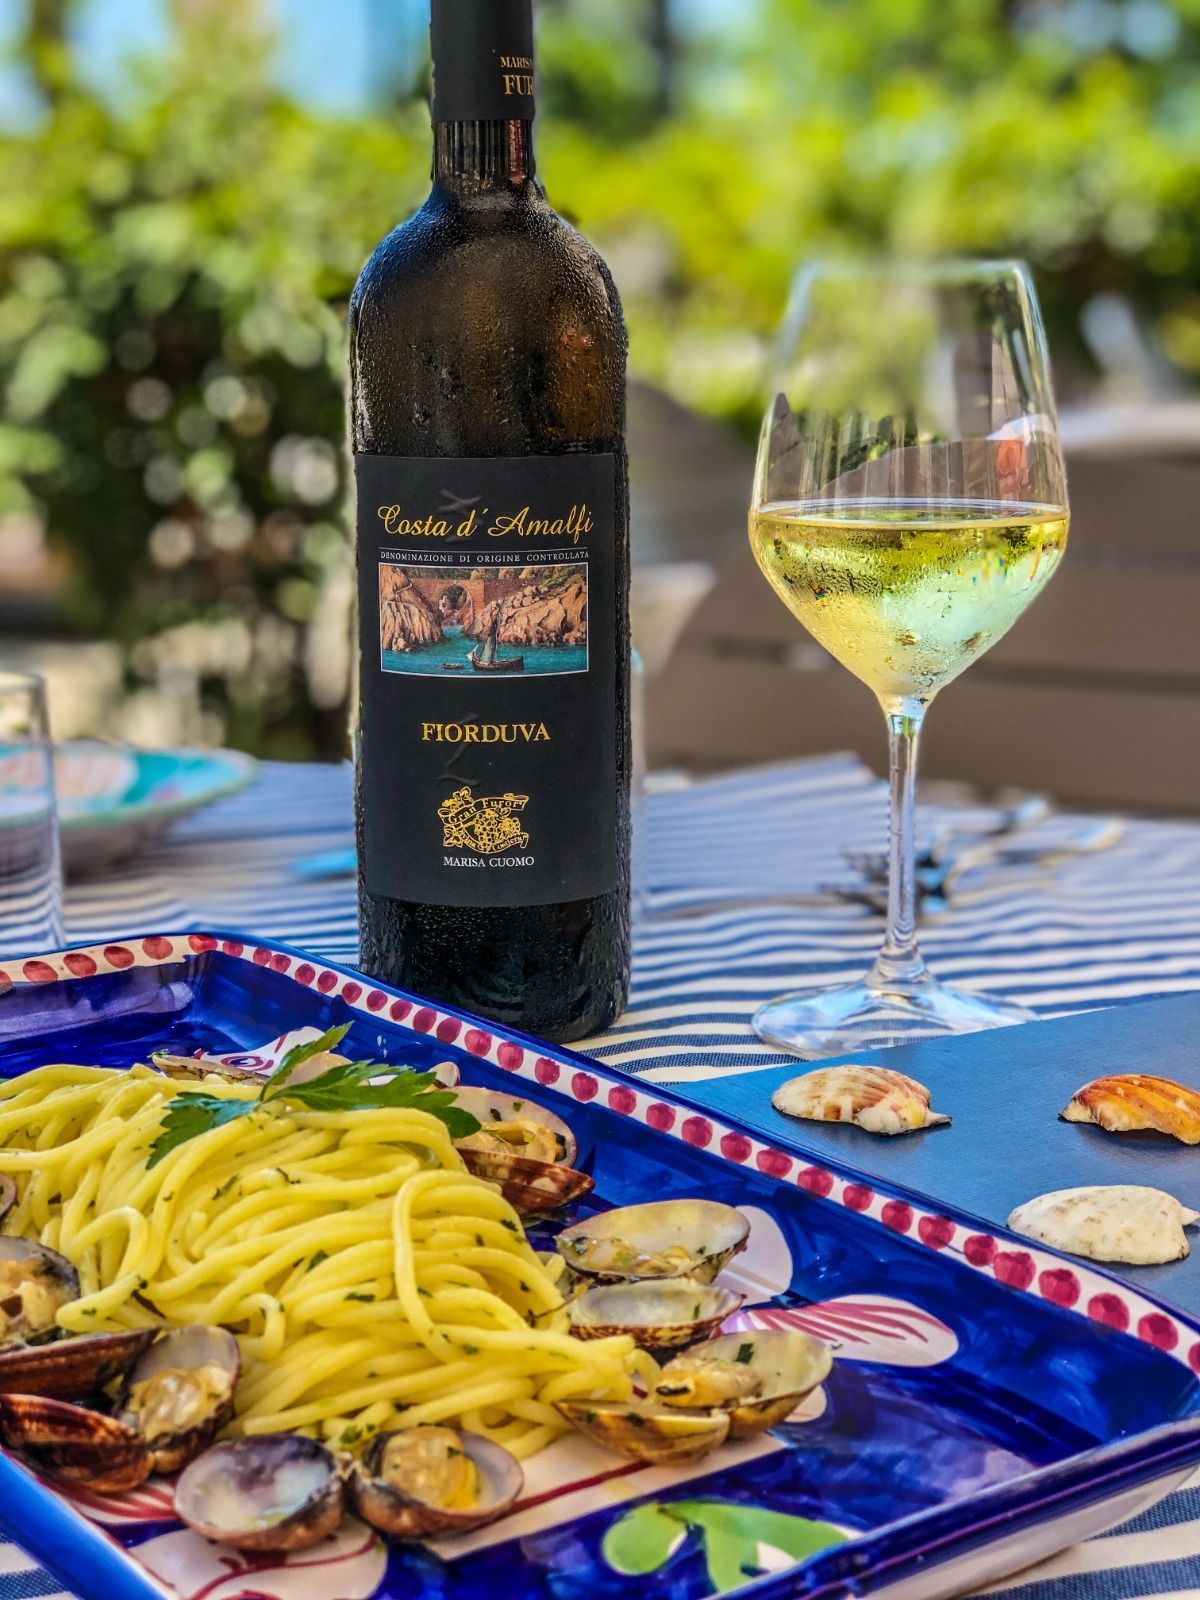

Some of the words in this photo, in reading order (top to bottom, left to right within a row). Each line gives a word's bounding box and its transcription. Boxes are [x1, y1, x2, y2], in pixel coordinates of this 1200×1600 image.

[378, 504, 453, 537] Costa
[380, 551, 453, 563] DENOMINAZIONE
[459, 555, 471, 563] DI
[477, 554, 521, 563] ORIGINE
[526, 551, 589, 562] CONTROLLATA
[421, 722, 551, 743] FIORDUVA
[449, 806, 477, 824] Gran
[443, 856, 485, 867] MARISA
[489, 856, 535, 867] CUOMO
